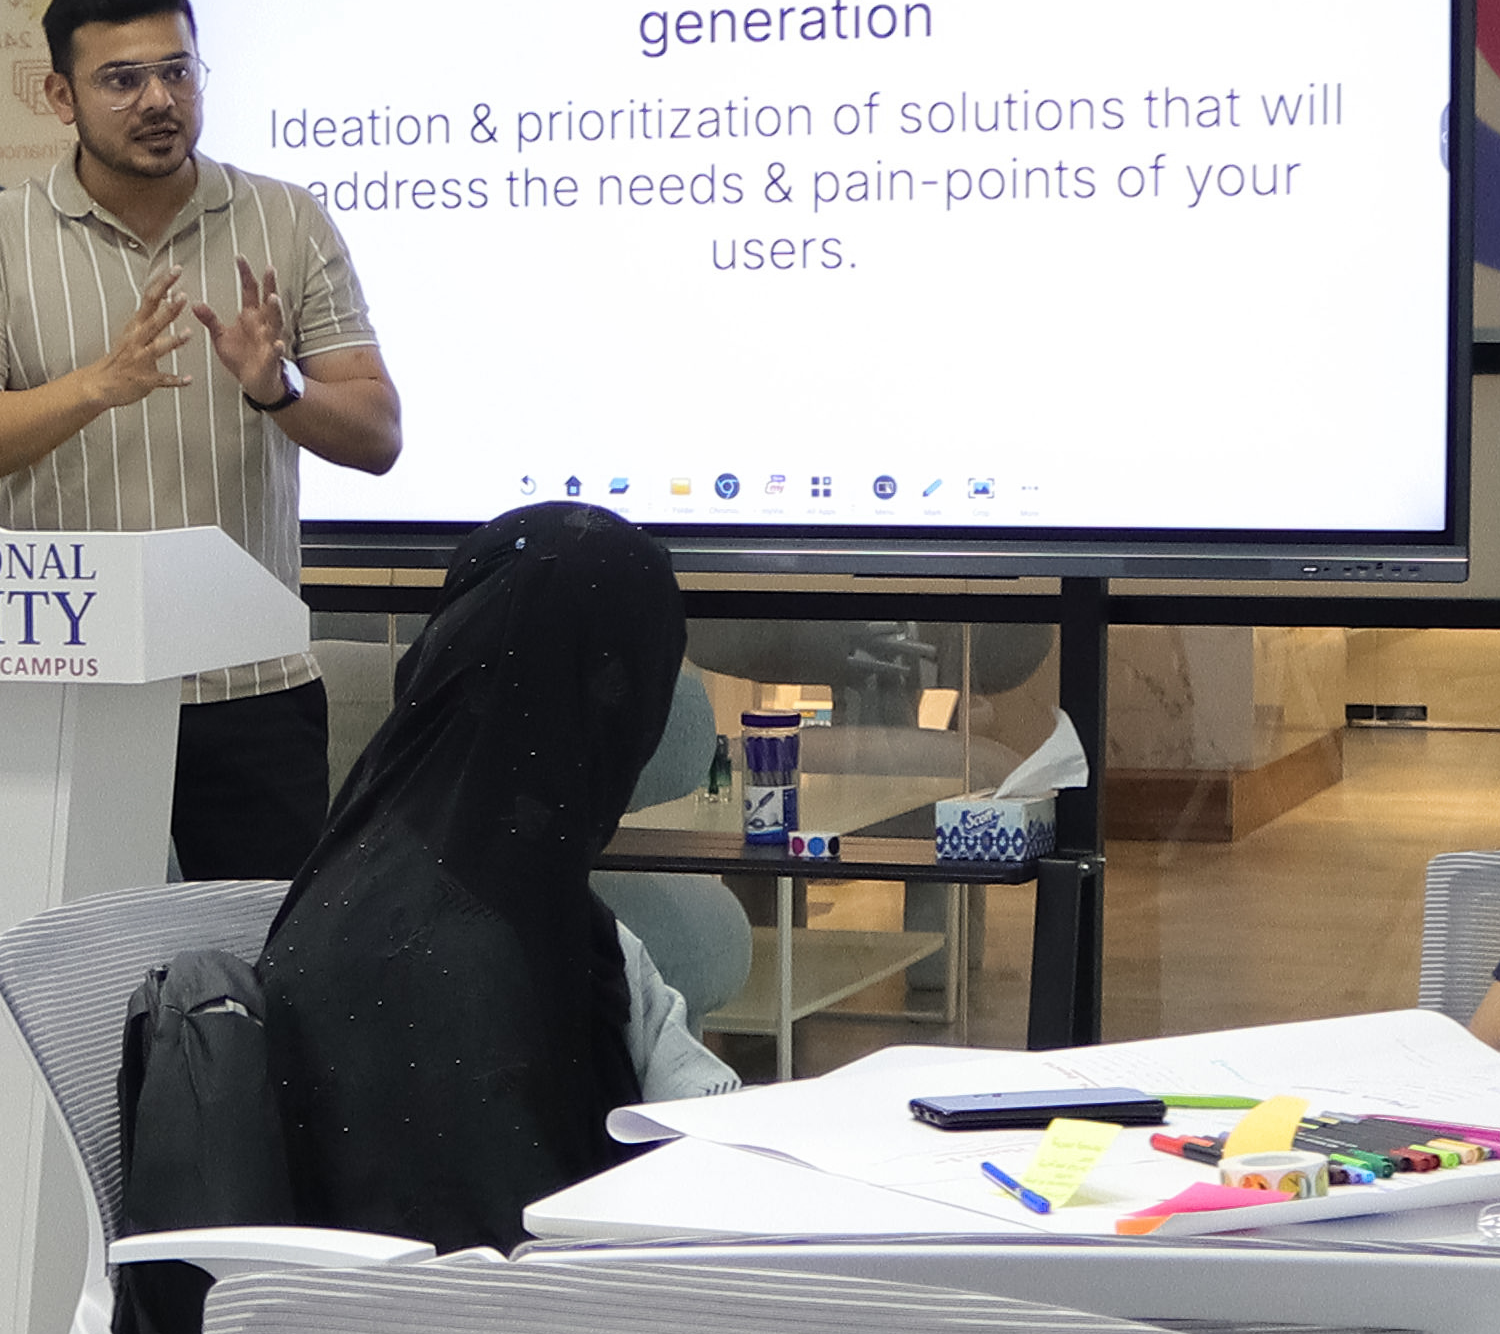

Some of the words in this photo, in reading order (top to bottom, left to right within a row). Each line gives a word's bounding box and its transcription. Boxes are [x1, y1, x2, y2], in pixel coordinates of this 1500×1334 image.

[271, 105, 450, 149] Ideation
[469, 102, 499, 145] &
[517, 95, 812, 154] prioritization
[833, 90, 881, 136] of
[900, 89, 1125, 135] solutions
[1143, 86, 1241, 129] that
[1260, 82, 1342, 127] will
[306, 170, 489, 212] address
[505, 167, 579, 208] the
[599, 163, 744, 207] needs
[763, 161, 793, 204] &
[813, 156, 1096, 213] pain-points
[1117, 152, 1167, 199] of
[1185, 162, 1302, 209] your
[712, 237, 857, 271] users.
[0, 656, 99, 677] CAMPUS
